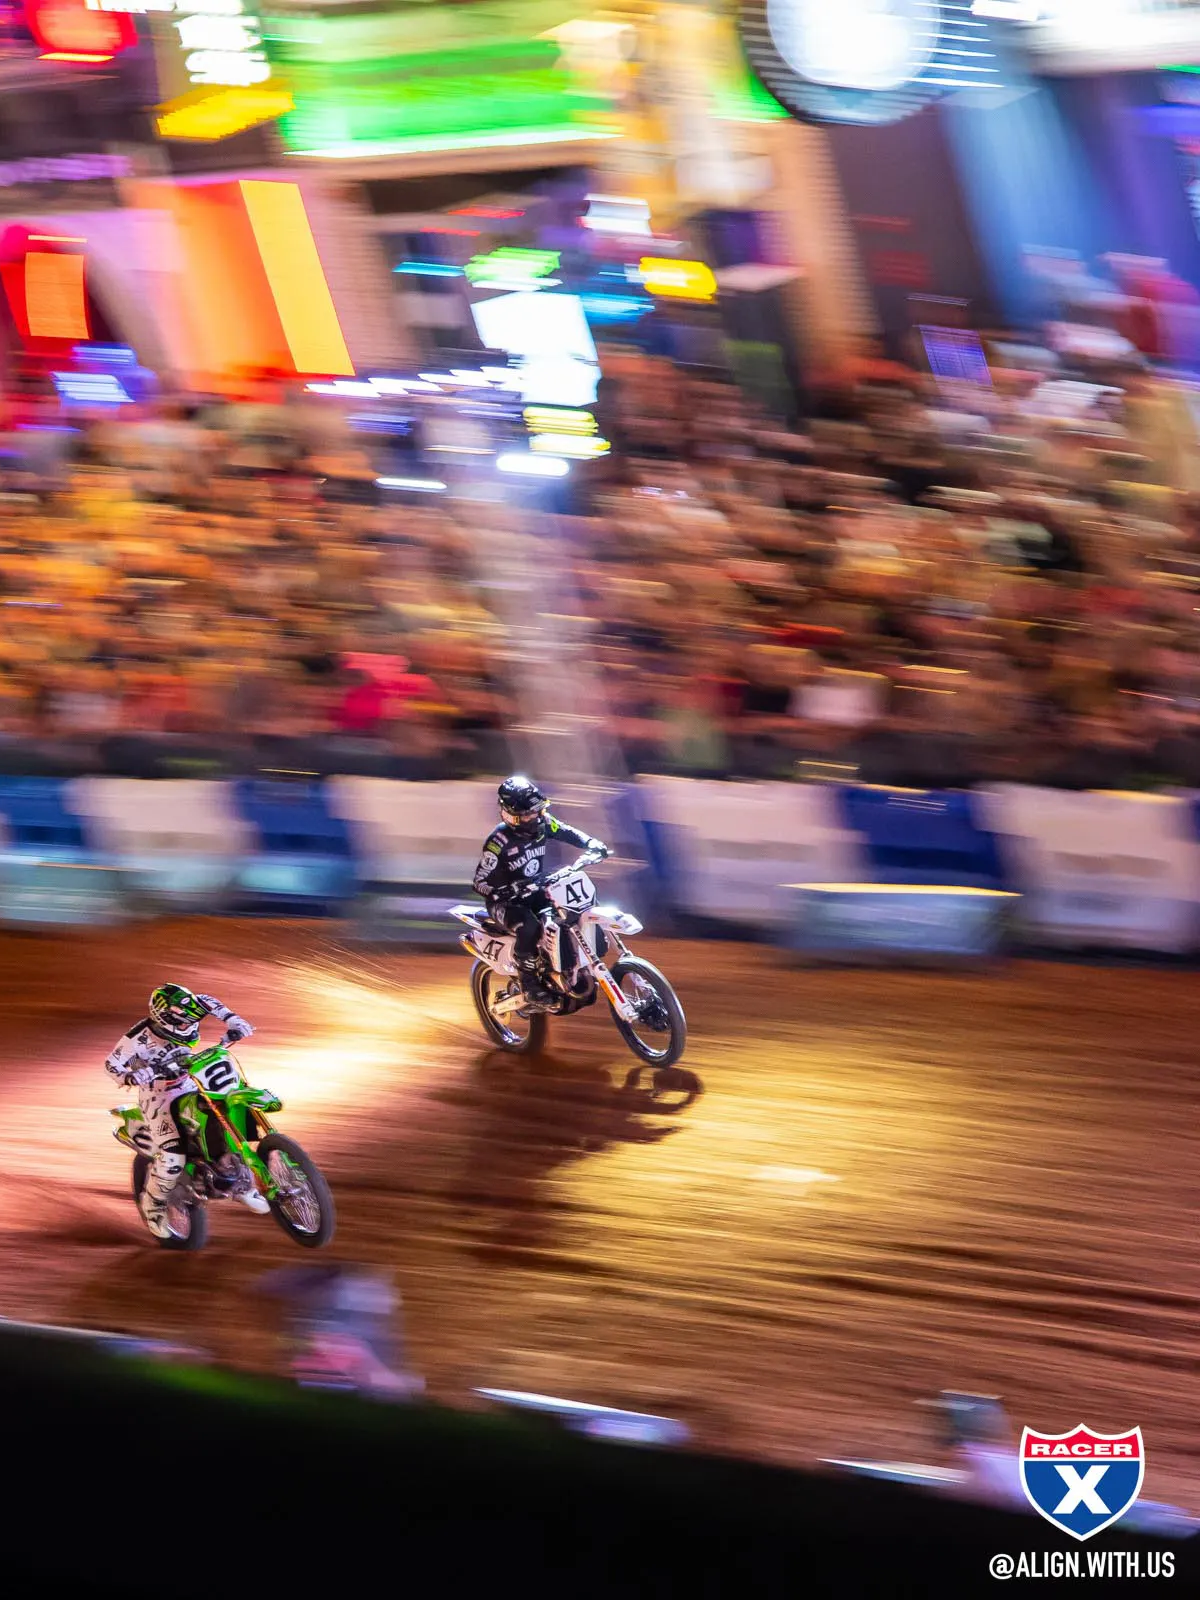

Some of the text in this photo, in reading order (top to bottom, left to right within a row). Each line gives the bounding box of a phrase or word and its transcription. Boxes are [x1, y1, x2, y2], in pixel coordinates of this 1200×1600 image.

[525, 845, 546, 861] DANIE
[565, 879, 590, 905] 47
[483, 940, 505, 961] 47
[575, 930, 591, 954] ENZO
[205, 1061, 237, 1092] 2
